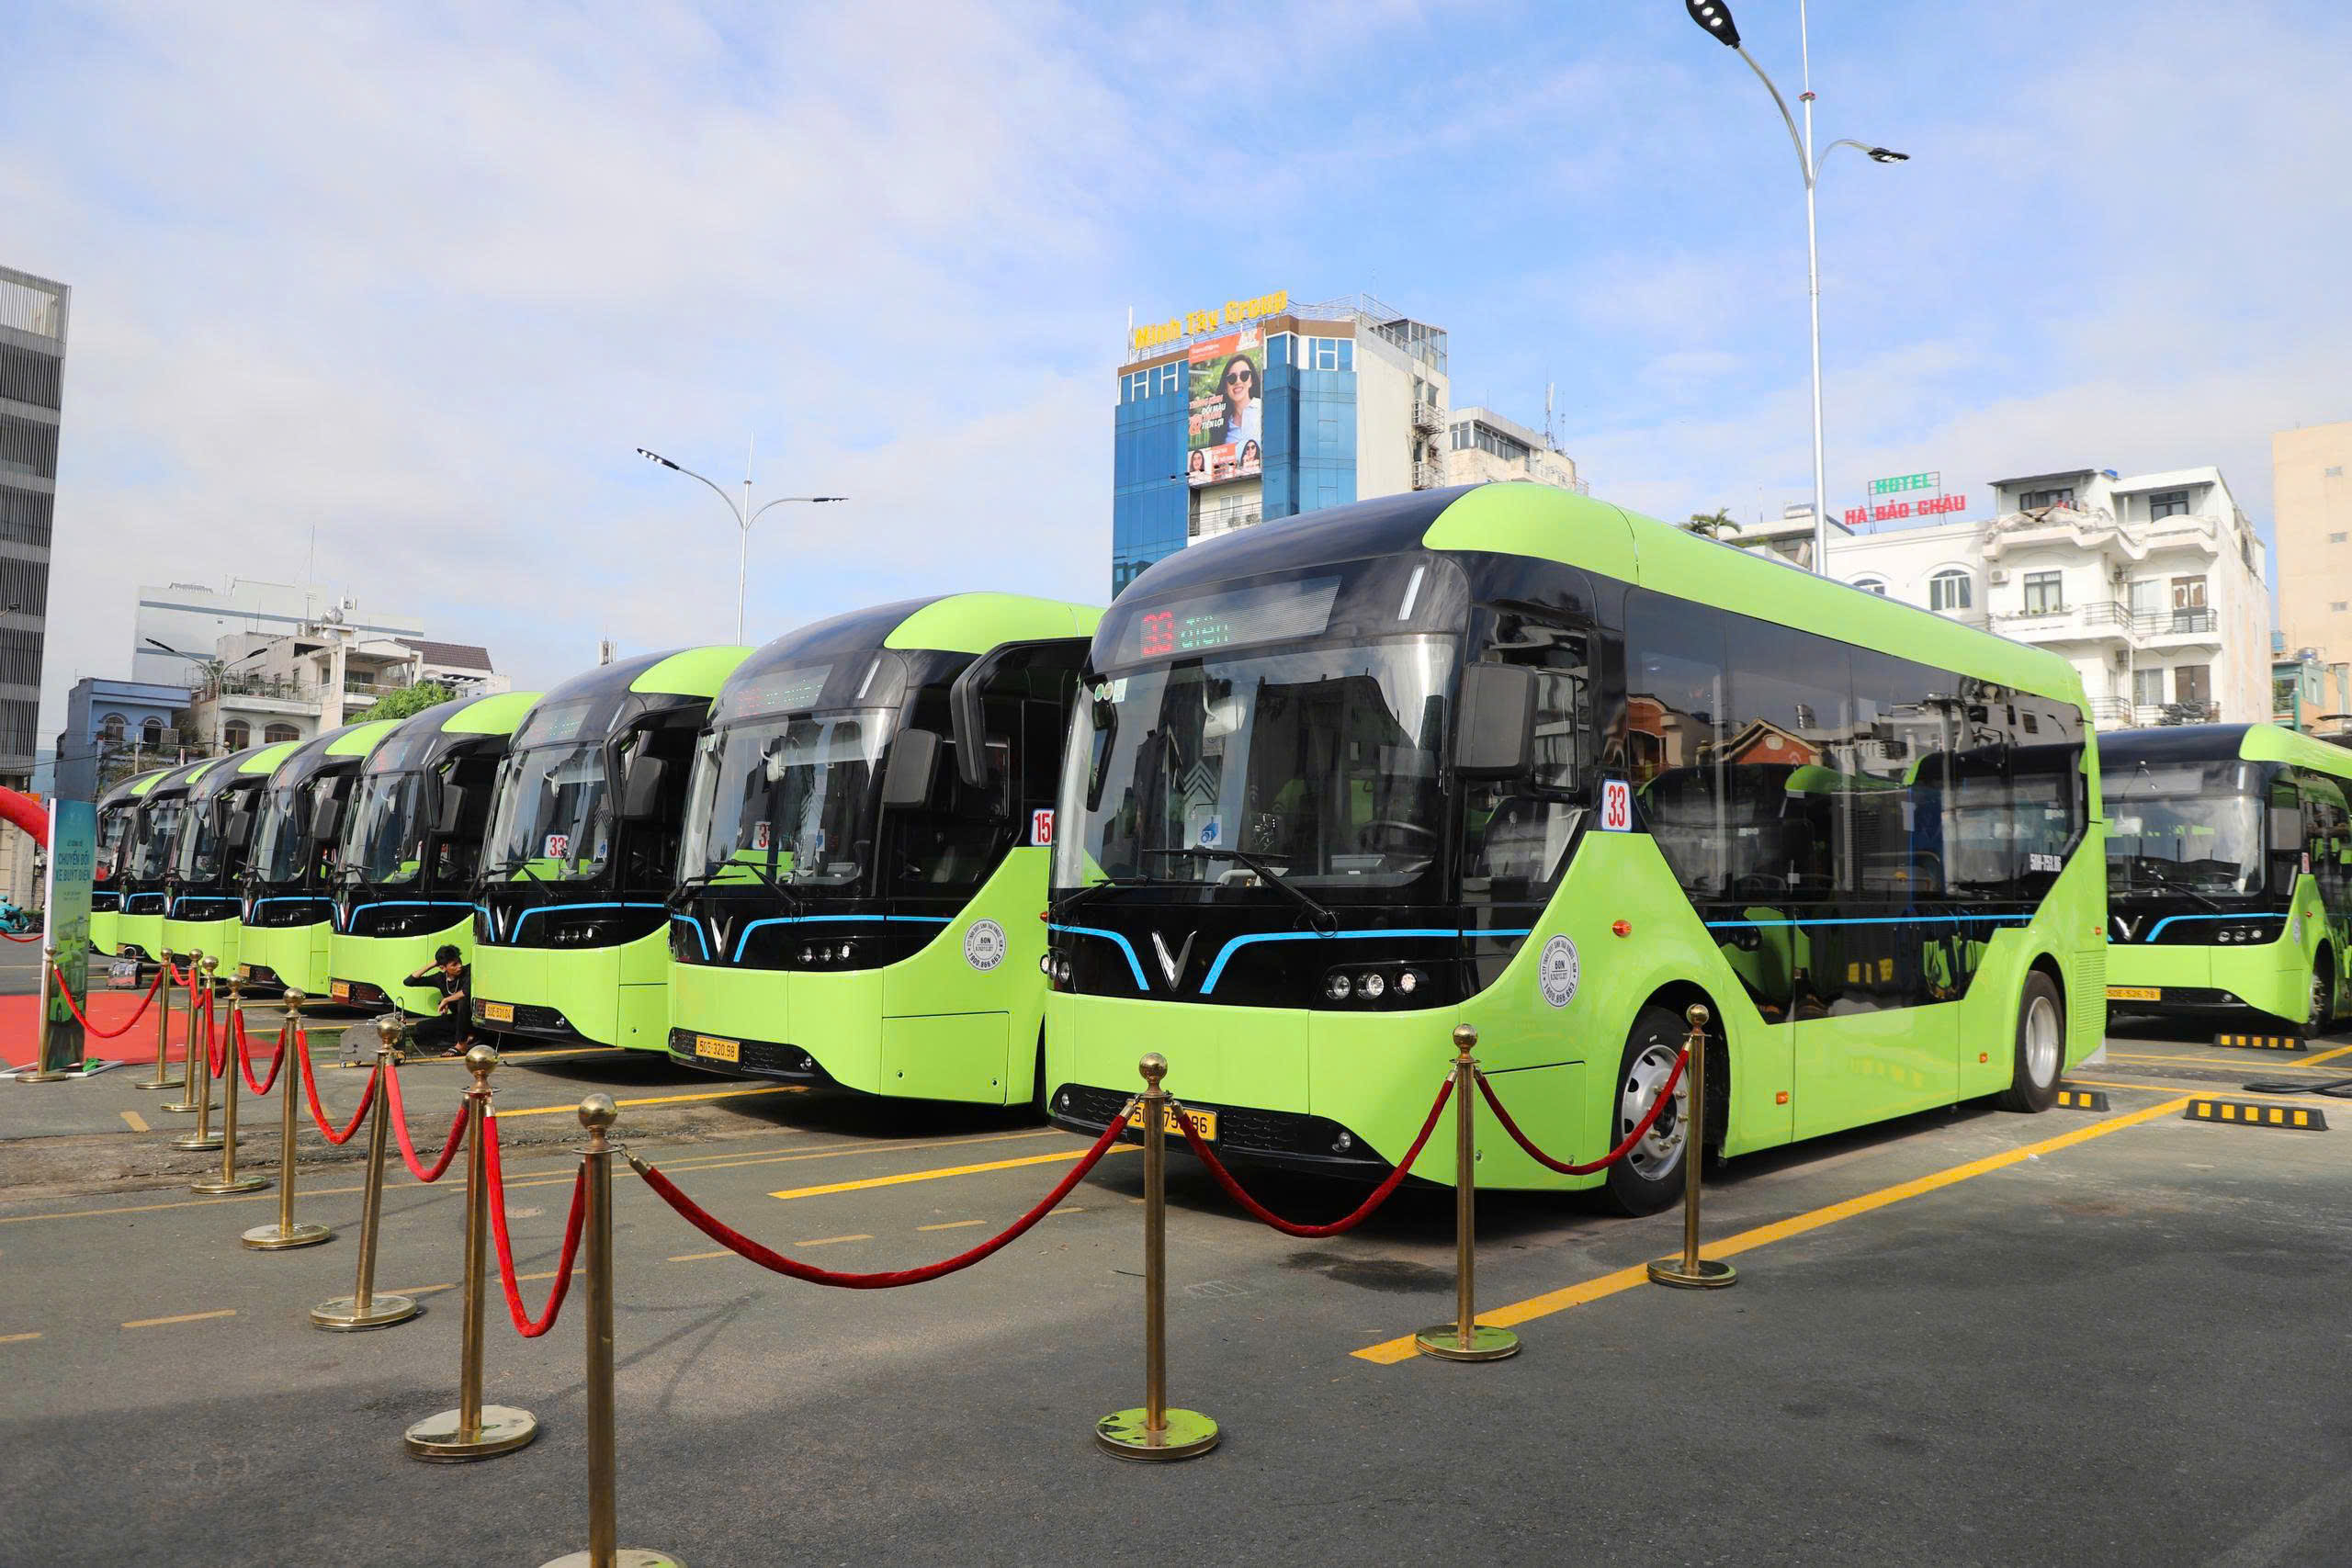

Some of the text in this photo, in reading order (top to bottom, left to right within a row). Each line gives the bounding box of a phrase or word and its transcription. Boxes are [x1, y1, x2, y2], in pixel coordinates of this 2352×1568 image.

[1135, 316, 1182, 350] Minh
[1225, 289, 1287, 324] Group
[1875, 474, 1932, 493] HOTEL
[1845, 505, 1867, 525] HÀ
[1875, 499, 1909, 521] BẢO
[1609, 785, 1624, 827] 33
[550, 837, 565, 856] 33
